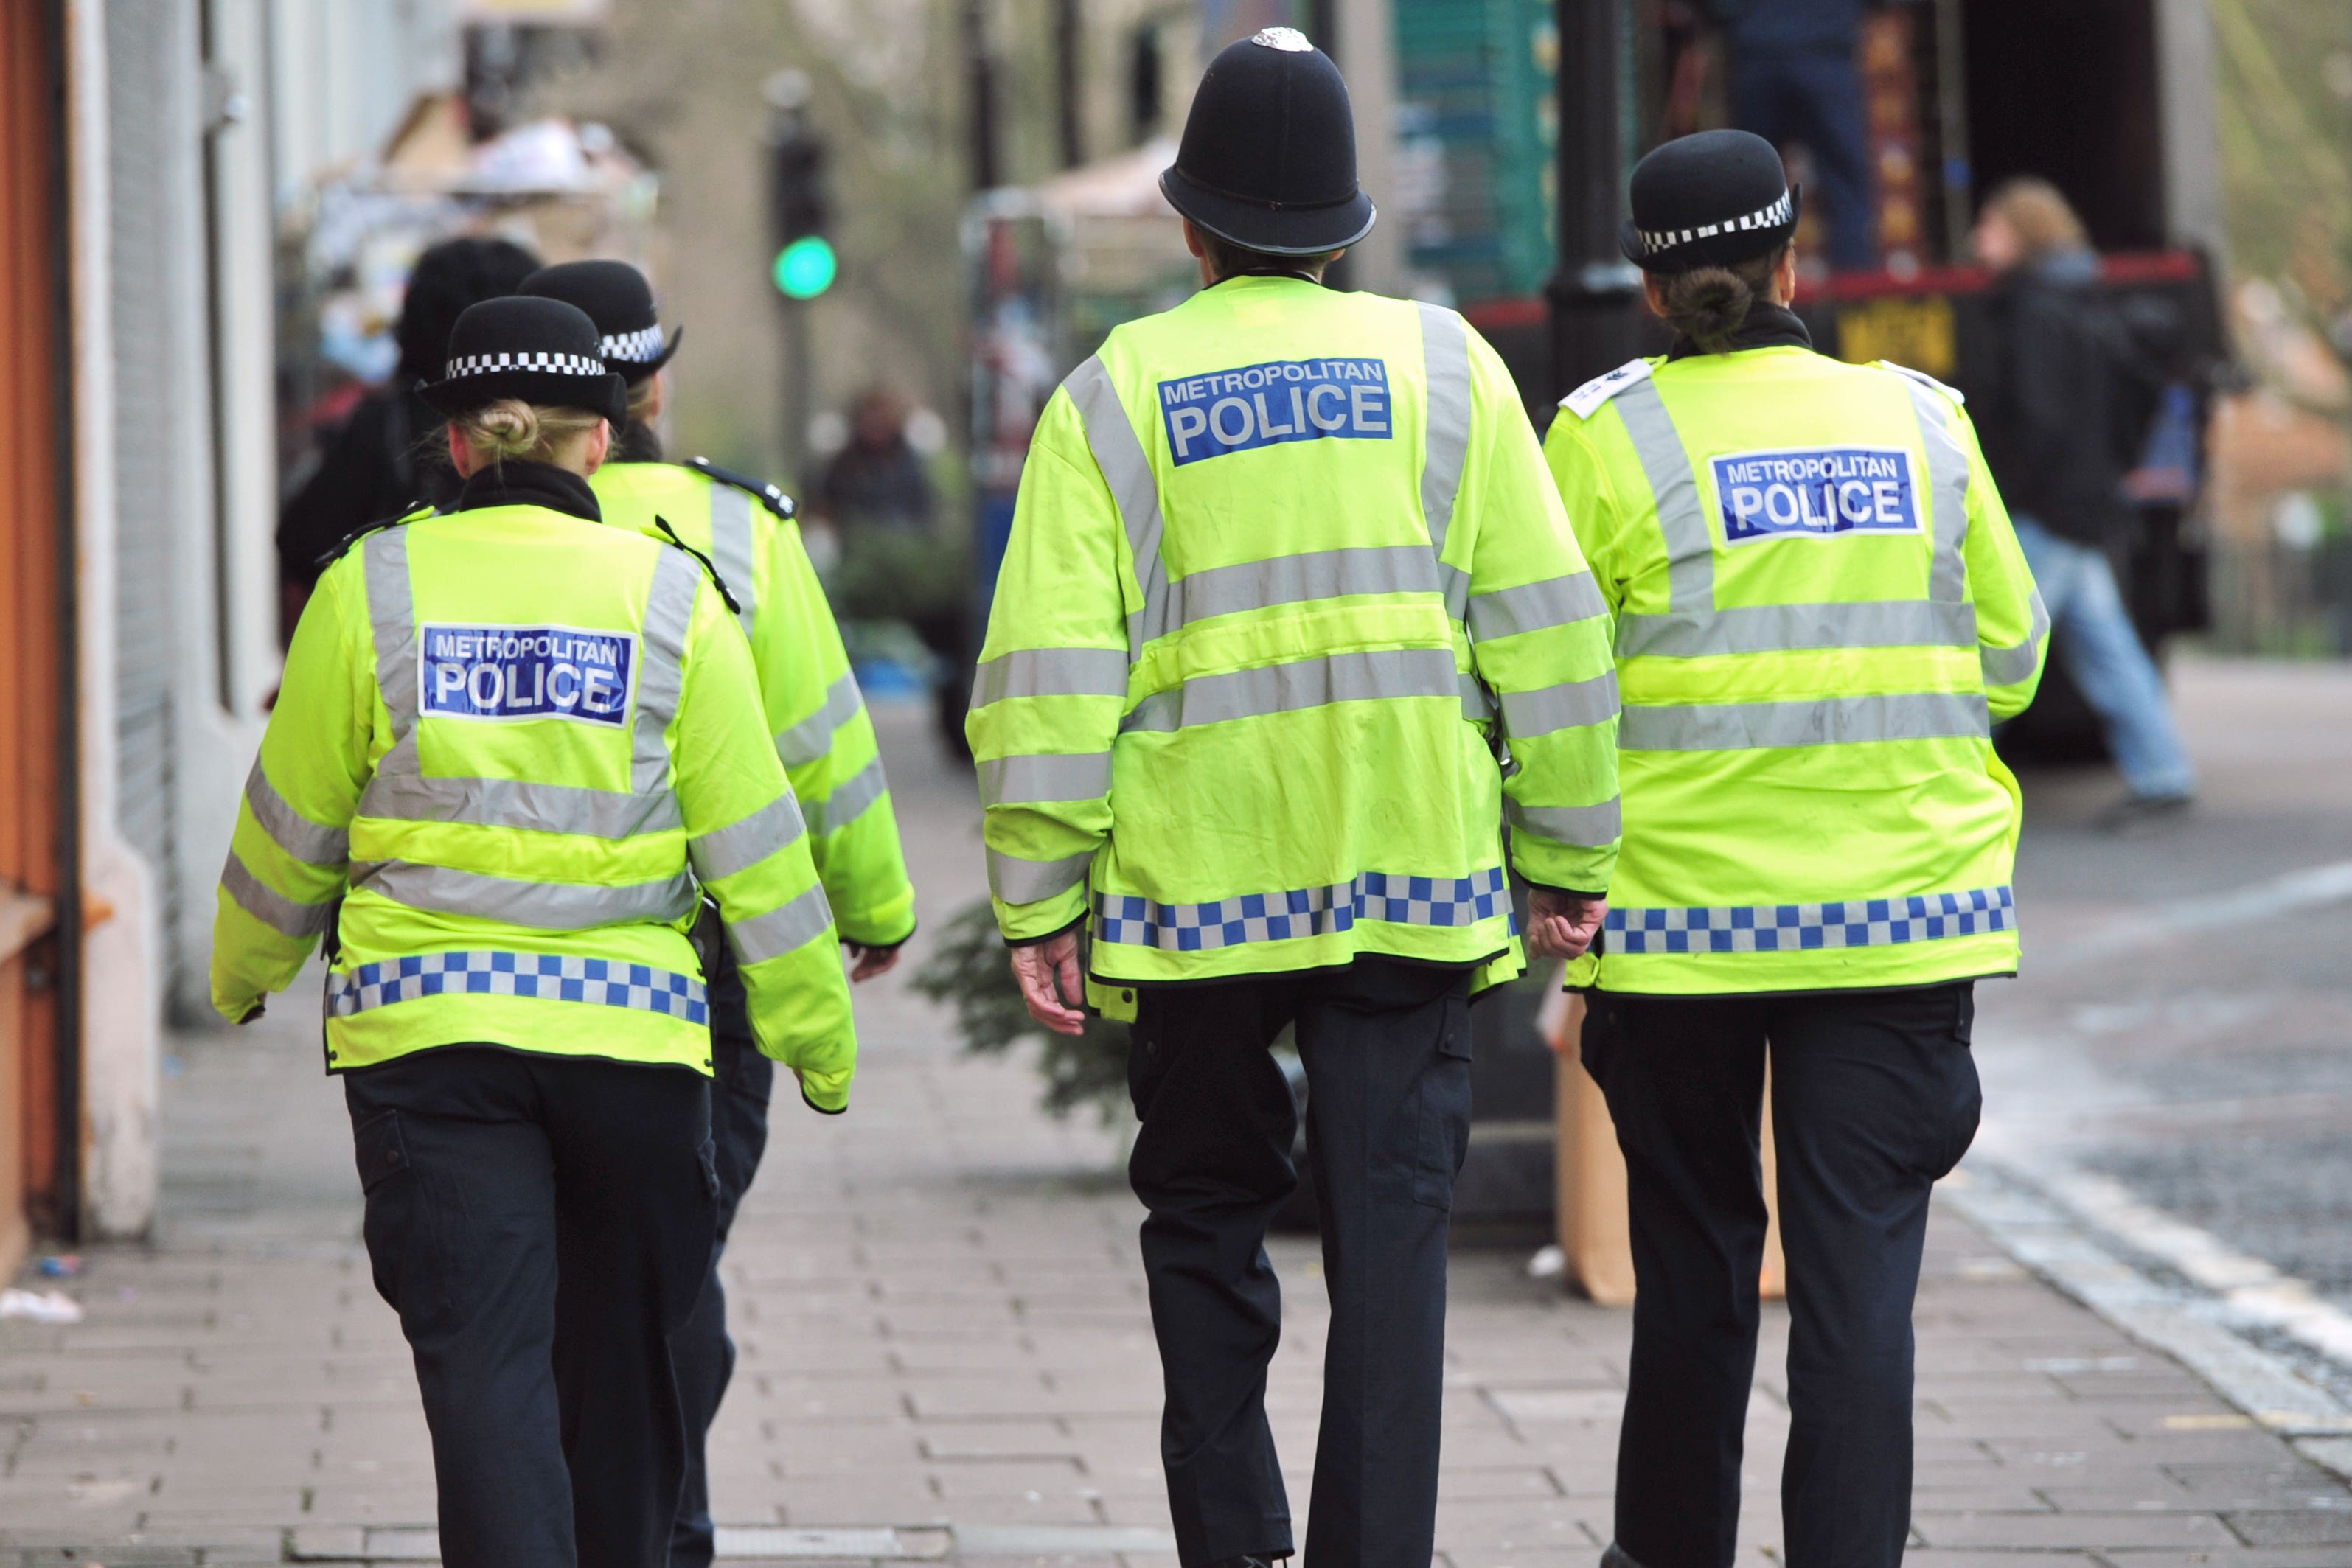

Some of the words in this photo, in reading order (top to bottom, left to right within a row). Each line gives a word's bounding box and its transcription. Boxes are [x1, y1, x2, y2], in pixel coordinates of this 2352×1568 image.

[1164, 361, 1383, 405] METROPOLITAN
[1169, 383, 1387, 457] POLICE
[1726, 456, 1897, 484] METROPOLITAN
[1732, 480, 1903, 531] POLICE
[436, 635, 617, 666] METROPOLITAN
[436, 662, 613, 713] POLICE
